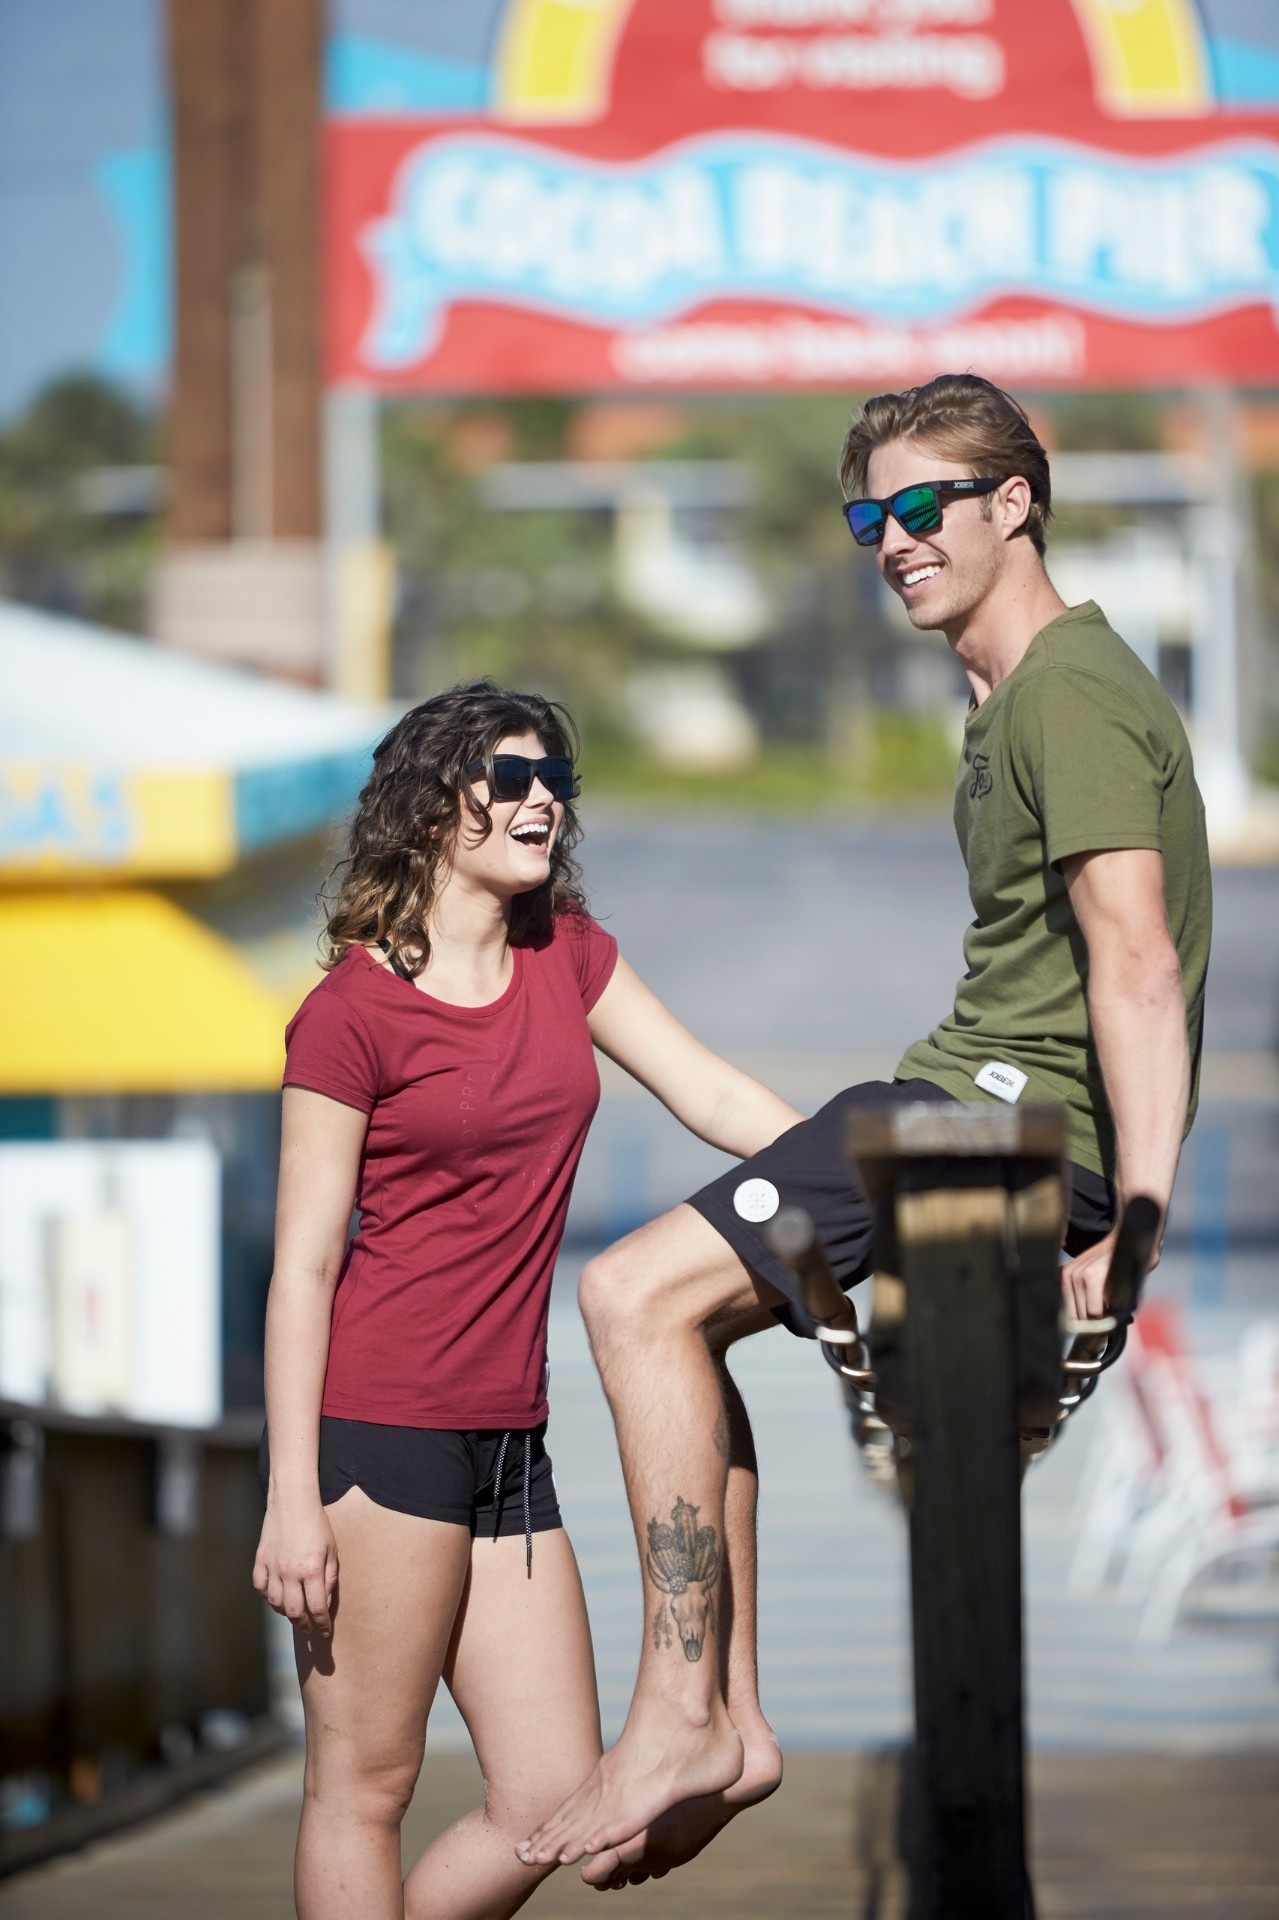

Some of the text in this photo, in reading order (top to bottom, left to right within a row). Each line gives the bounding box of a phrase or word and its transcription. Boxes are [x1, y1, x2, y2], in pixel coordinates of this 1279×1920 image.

[418, 155, 1273, 296] COCOA BEACH PIER
[988, 1071, 1011, 1086] JOBE
